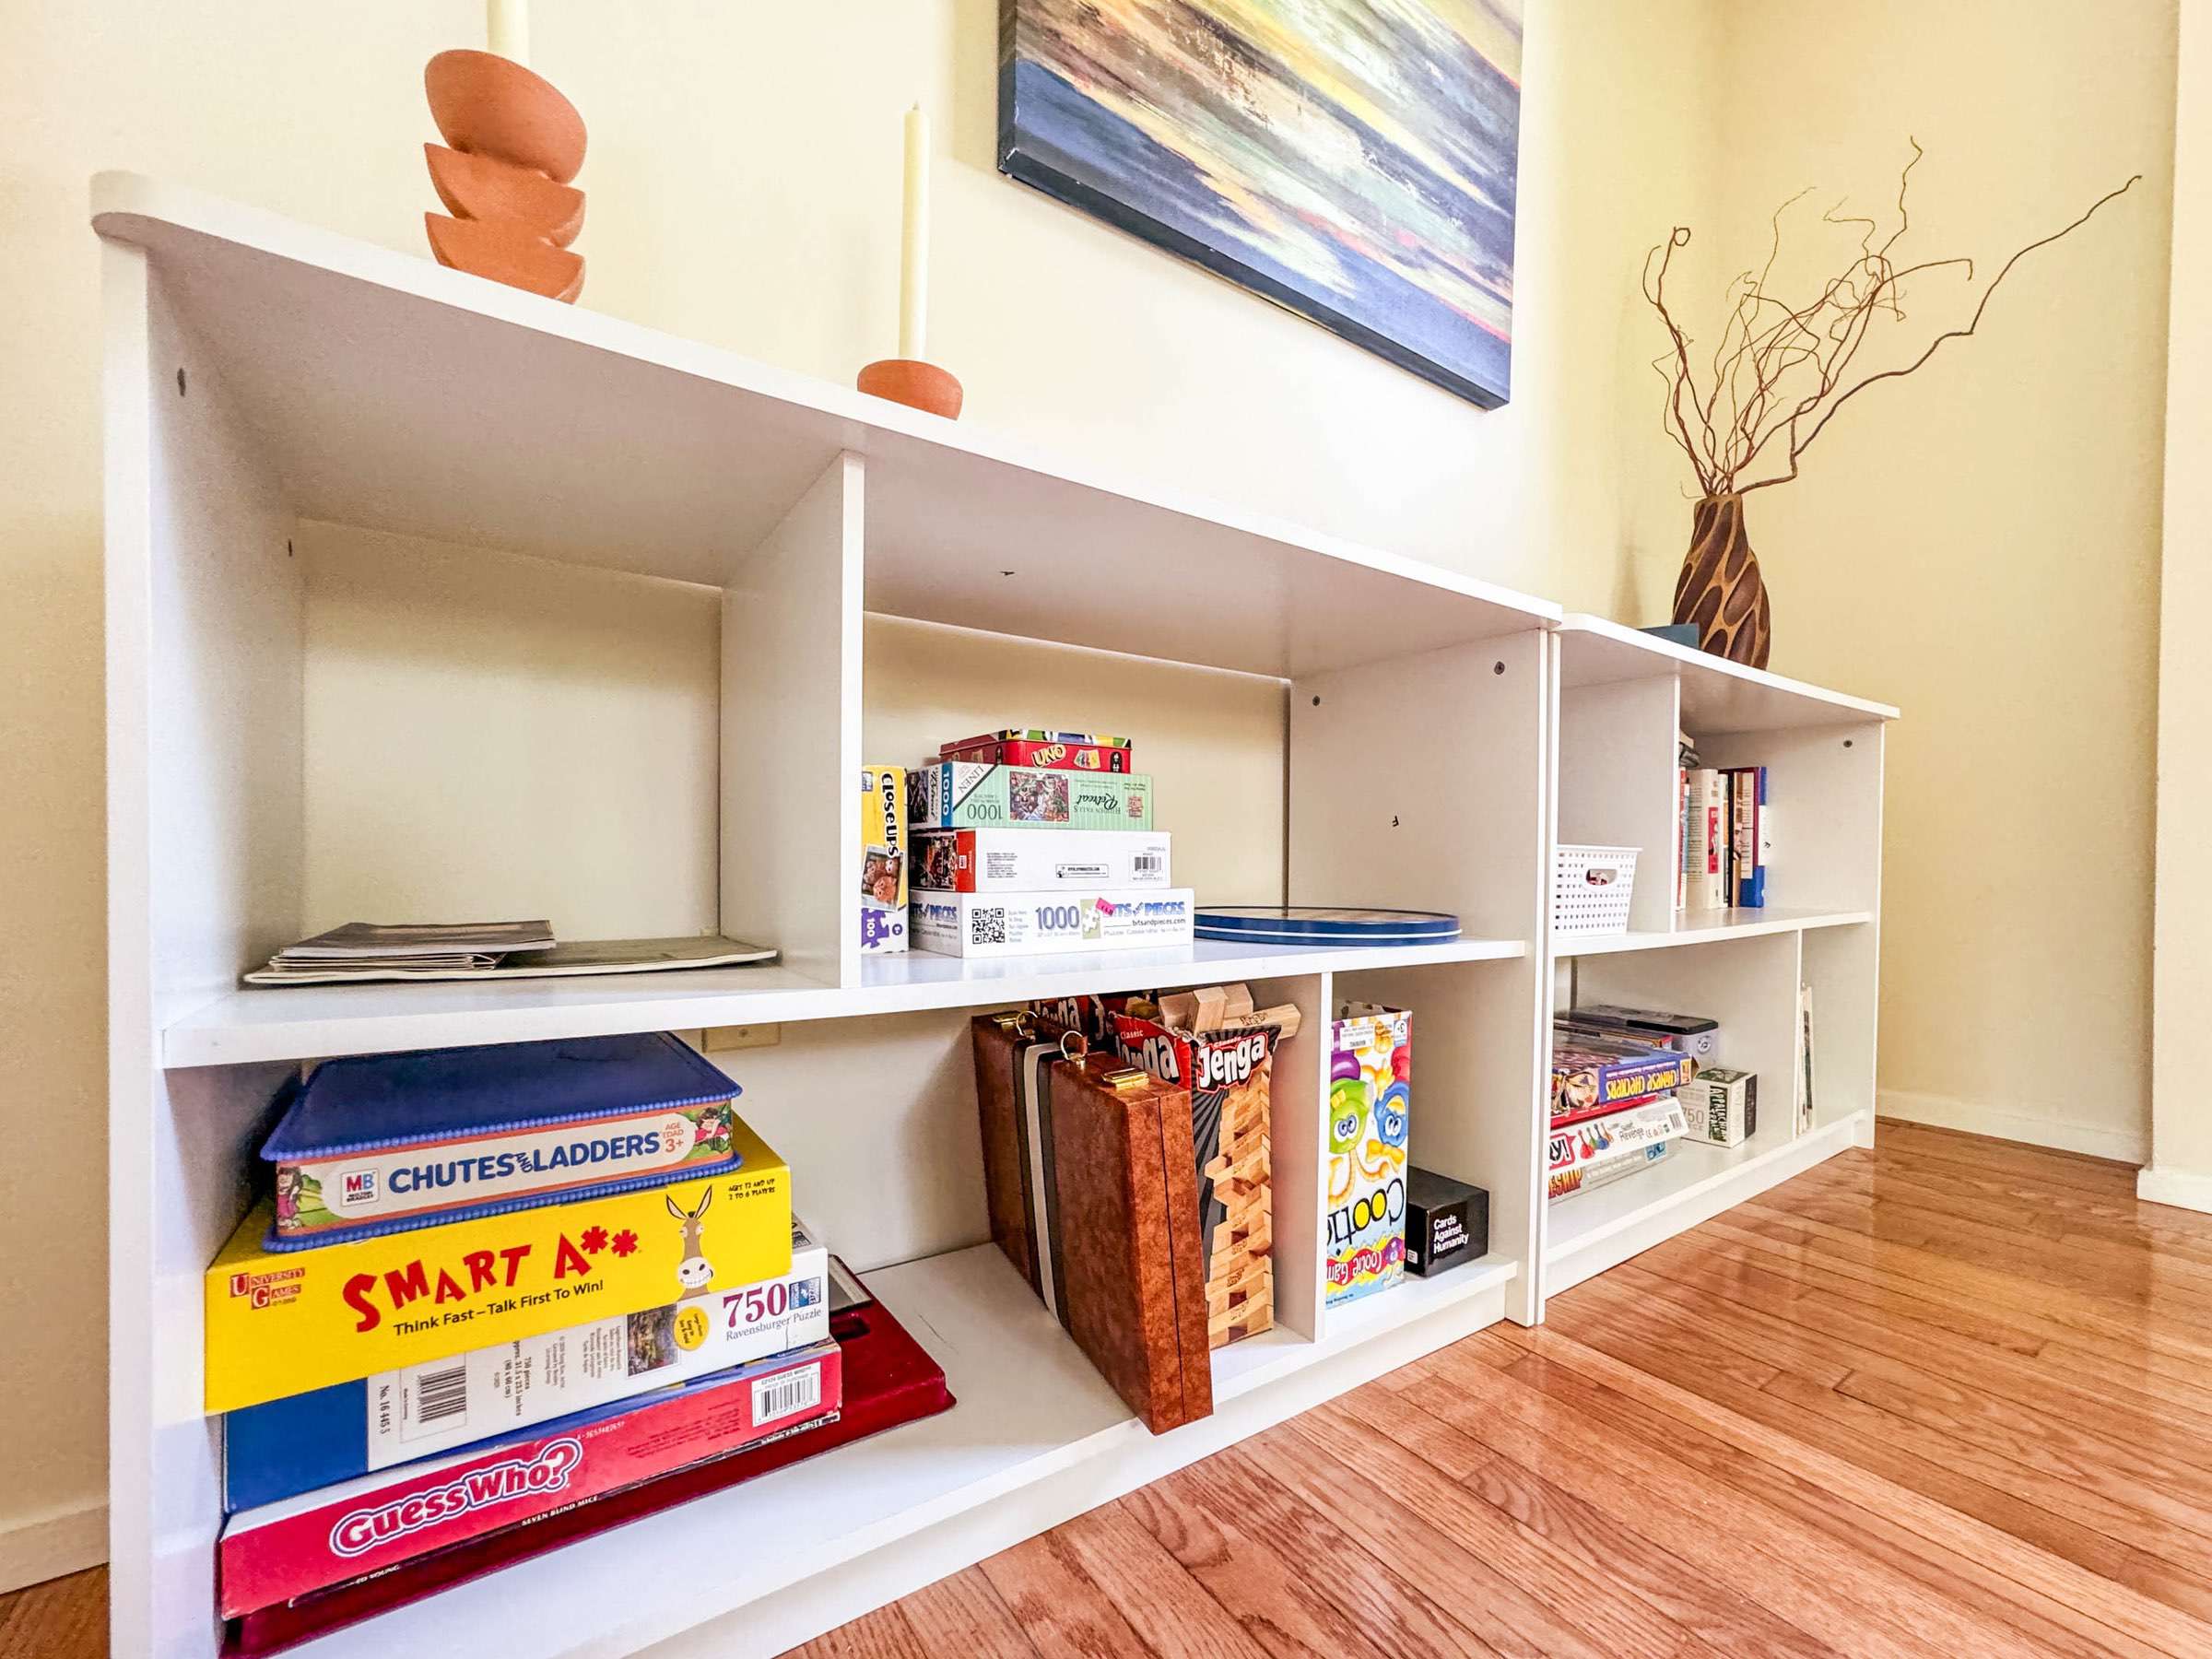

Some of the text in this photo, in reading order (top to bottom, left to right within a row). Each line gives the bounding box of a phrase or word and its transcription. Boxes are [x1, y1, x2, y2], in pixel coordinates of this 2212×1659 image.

[1032, 744, 1066, 768] UNO
[958, 765, 984, 793] LINEN
[968, 804, 1003, 820] 1000
[1077, 793, 1118, 810] Retreat
[1035, 906, 1080, 930] 1000
[1144, 900, 1185, 916] PIECES
[1120, 1028, 1144, 1040] Classic
[1200, 1035, 1266, 1087] Jenga
[665, 1122, 681, 1131] AGE
[665, 1137, 684, 1152] 3+
[388, 1132, 660, 1194] CHUTES AND LADDERS
[346, 1173, 374, 1193] MB
[1433, 1214, 1457, 1230] Cards
[1433, 1223, 1463, 1242] Against
[1433, 1232, 1469, 1254] Humanity
[230, 1268, 305, 1297] UNIVERSITY
[1327, 1263, 1348, 1284] Gam
[252, 1285, 301, 1309] GAMES
[343, 1244, 532, 1333] SMART
[394, 1315, 440, 1335] Think
[443, 1310, 475, 1324] Fast
[488, 1300, 516, 1315] Talk
[521, 1292, 550, 1307] First
[555, 1288, 571, 1300] To
[573, 1280, 604, 1296] Win!
[723, 1282, 787, 1328] 750
[725, 1315, 791, 1341] Ravensburger
[793, 1308, 822, 1324] Puzzle
[379, 1384, 390, 1400] No.
[334, 1441, 580, 1554] Guess Who?
[522, 1495, 599, 1525] SEVEN BLIND MICE
